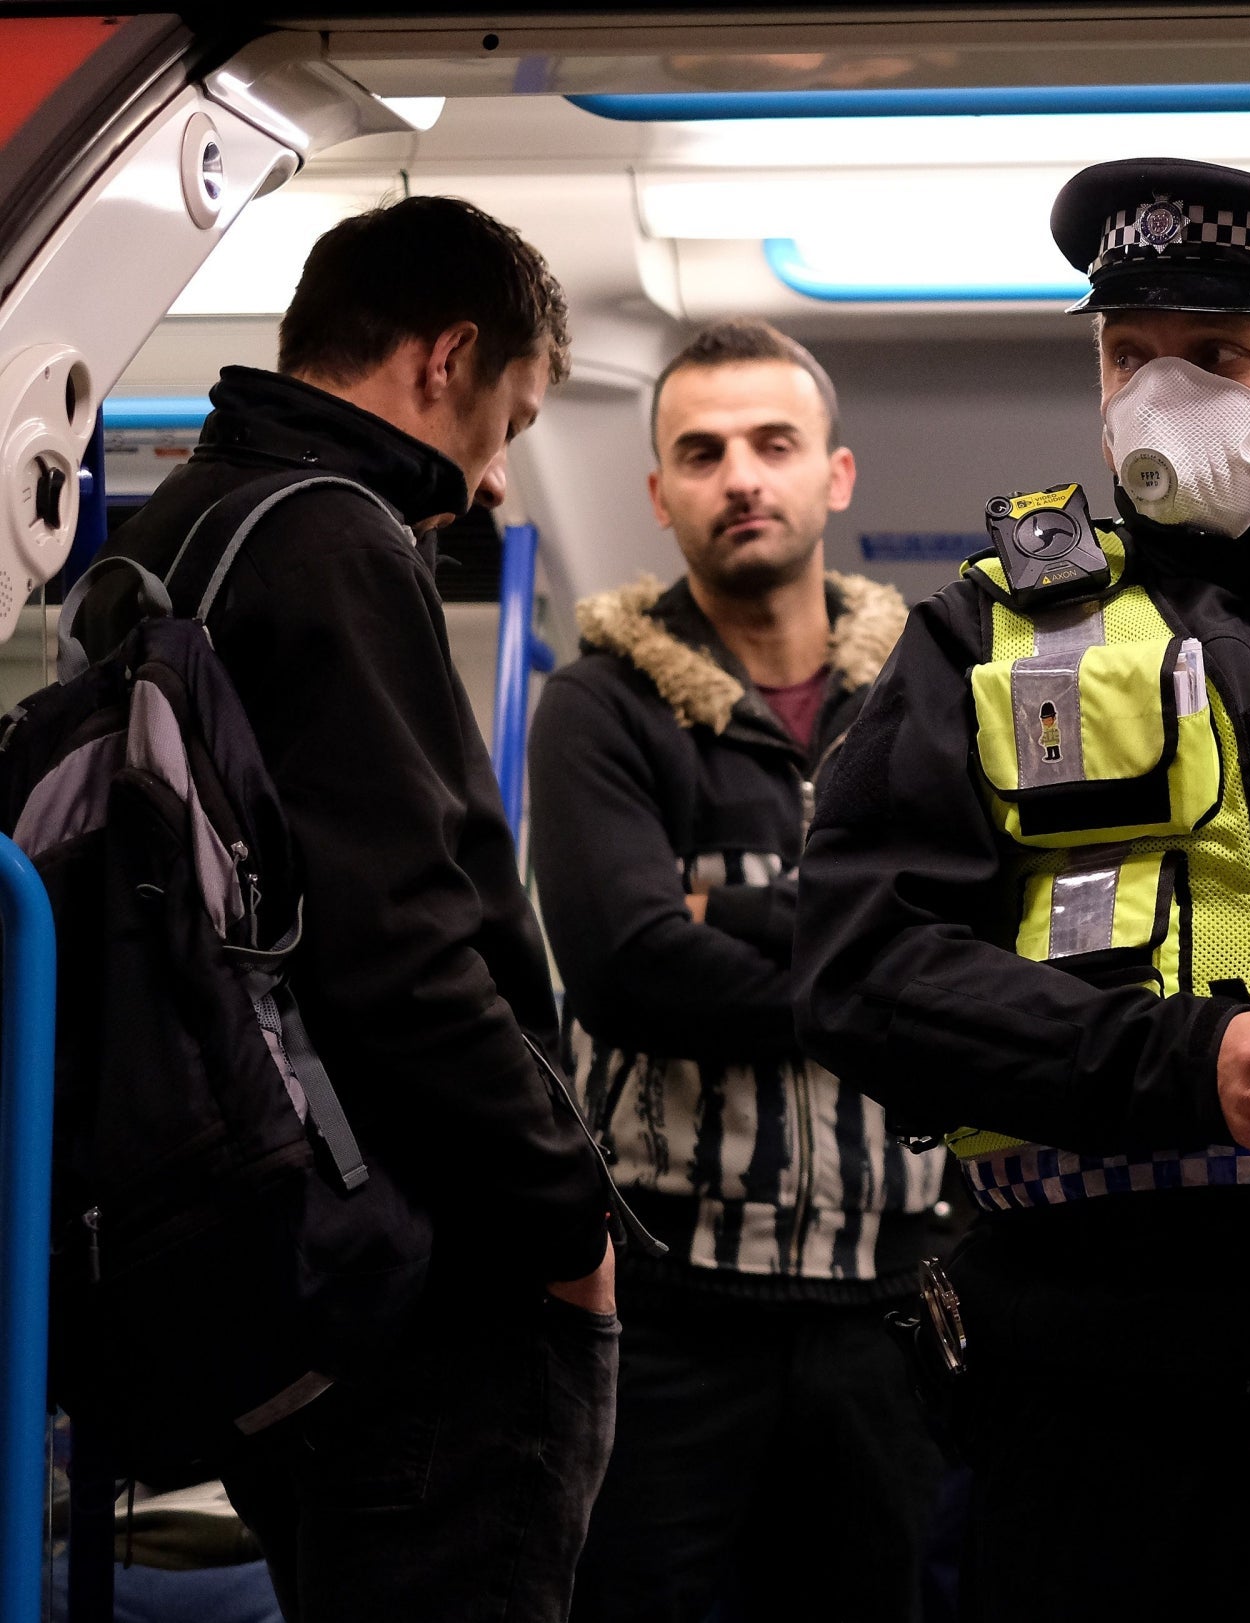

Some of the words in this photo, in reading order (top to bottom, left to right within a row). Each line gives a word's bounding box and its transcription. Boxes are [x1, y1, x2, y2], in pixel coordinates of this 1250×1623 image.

[1141, 471, 1160, 480] FFP2
[1034, 493, 1058, 503] VIDEO
[1043, 495, 1066, 505] AUDIO
[1052, 570, 1077, 581] AXON
